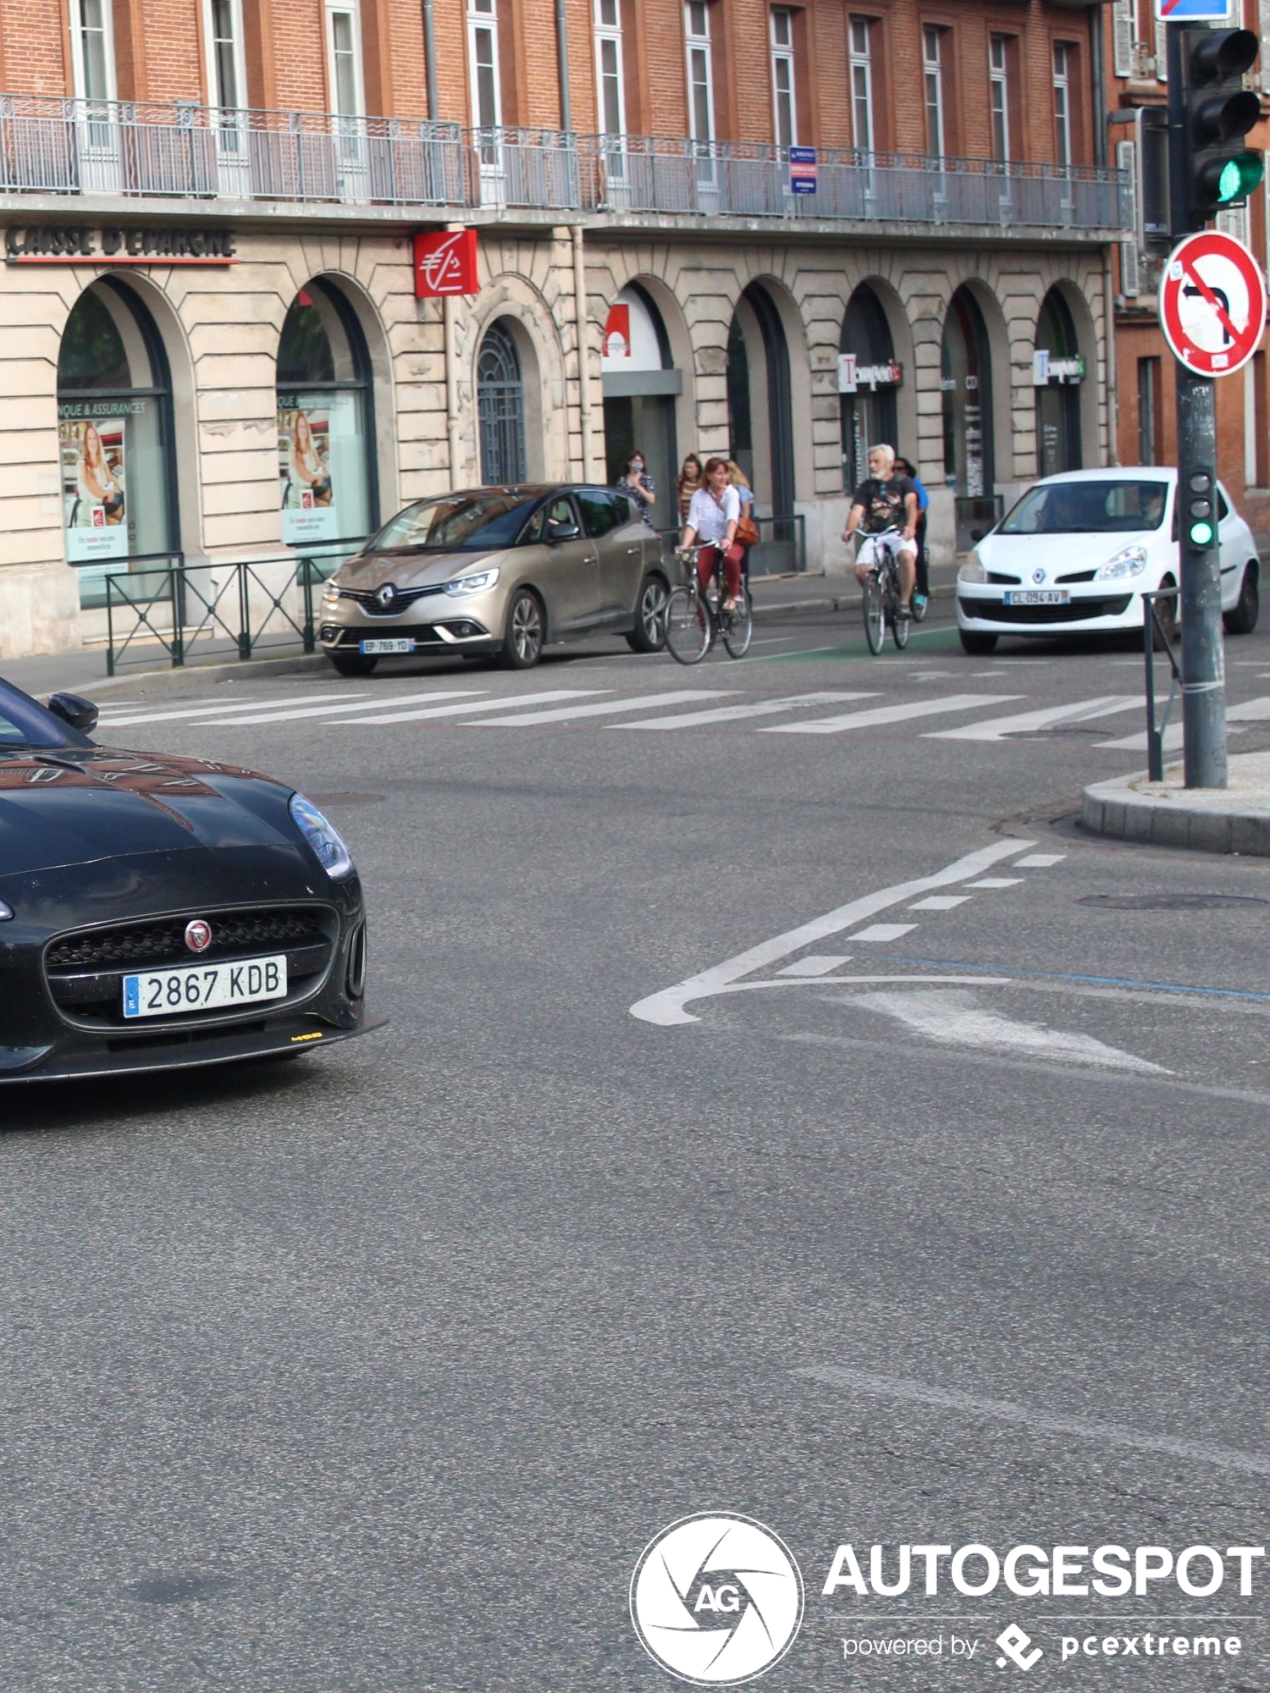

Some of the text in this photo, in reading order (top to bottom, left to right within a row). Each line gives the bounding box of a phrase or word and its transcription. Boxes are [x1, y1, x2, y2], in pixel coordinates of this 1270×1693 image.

[5, 226, 96, 256] CAISSE
[92, 402, 146, 415] ASSURANCES
[147, 970, 219, 1009] 2867
[229, 962, 280, 998] KDB
